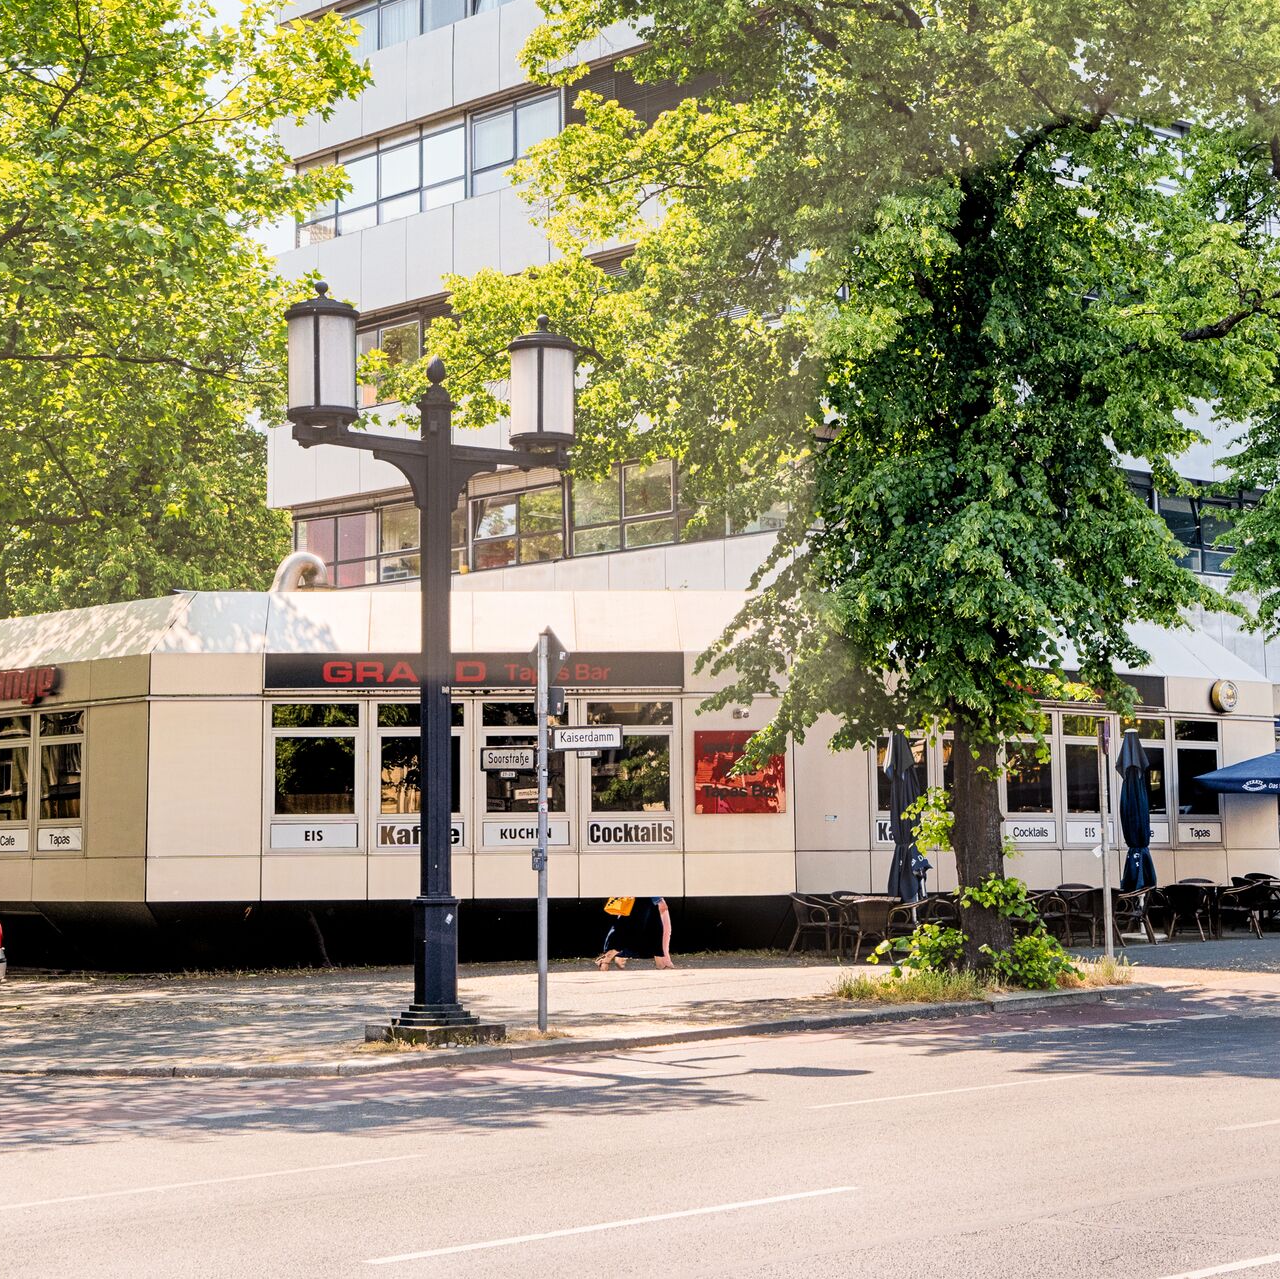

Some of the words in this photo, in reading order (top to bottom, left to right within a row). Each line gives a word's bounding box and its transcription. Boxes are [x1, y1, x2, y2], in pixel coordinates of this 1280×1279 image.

[322, 661, 486, 683] GRAD
[504, 663, 570, 685] Taps
[575, 663, 611, 681] Bar
[560, 732, 614, 743] Kaiserdamm
[488, 752, 530, 766] Soorstraße
[304, 830, 323, 841] EIS
[381, 825, 460, 845] Kafe
[590, 823, 673, 843] Cocktails
[1013, 827, 1049, 838] Cocktails
[1085, 827, 1096, 838] EIS
[1190, 828, 1211, 840] Tapas
[0, 835, 16, 846] Cafe
[49, 834, 71, 847] Tapas
